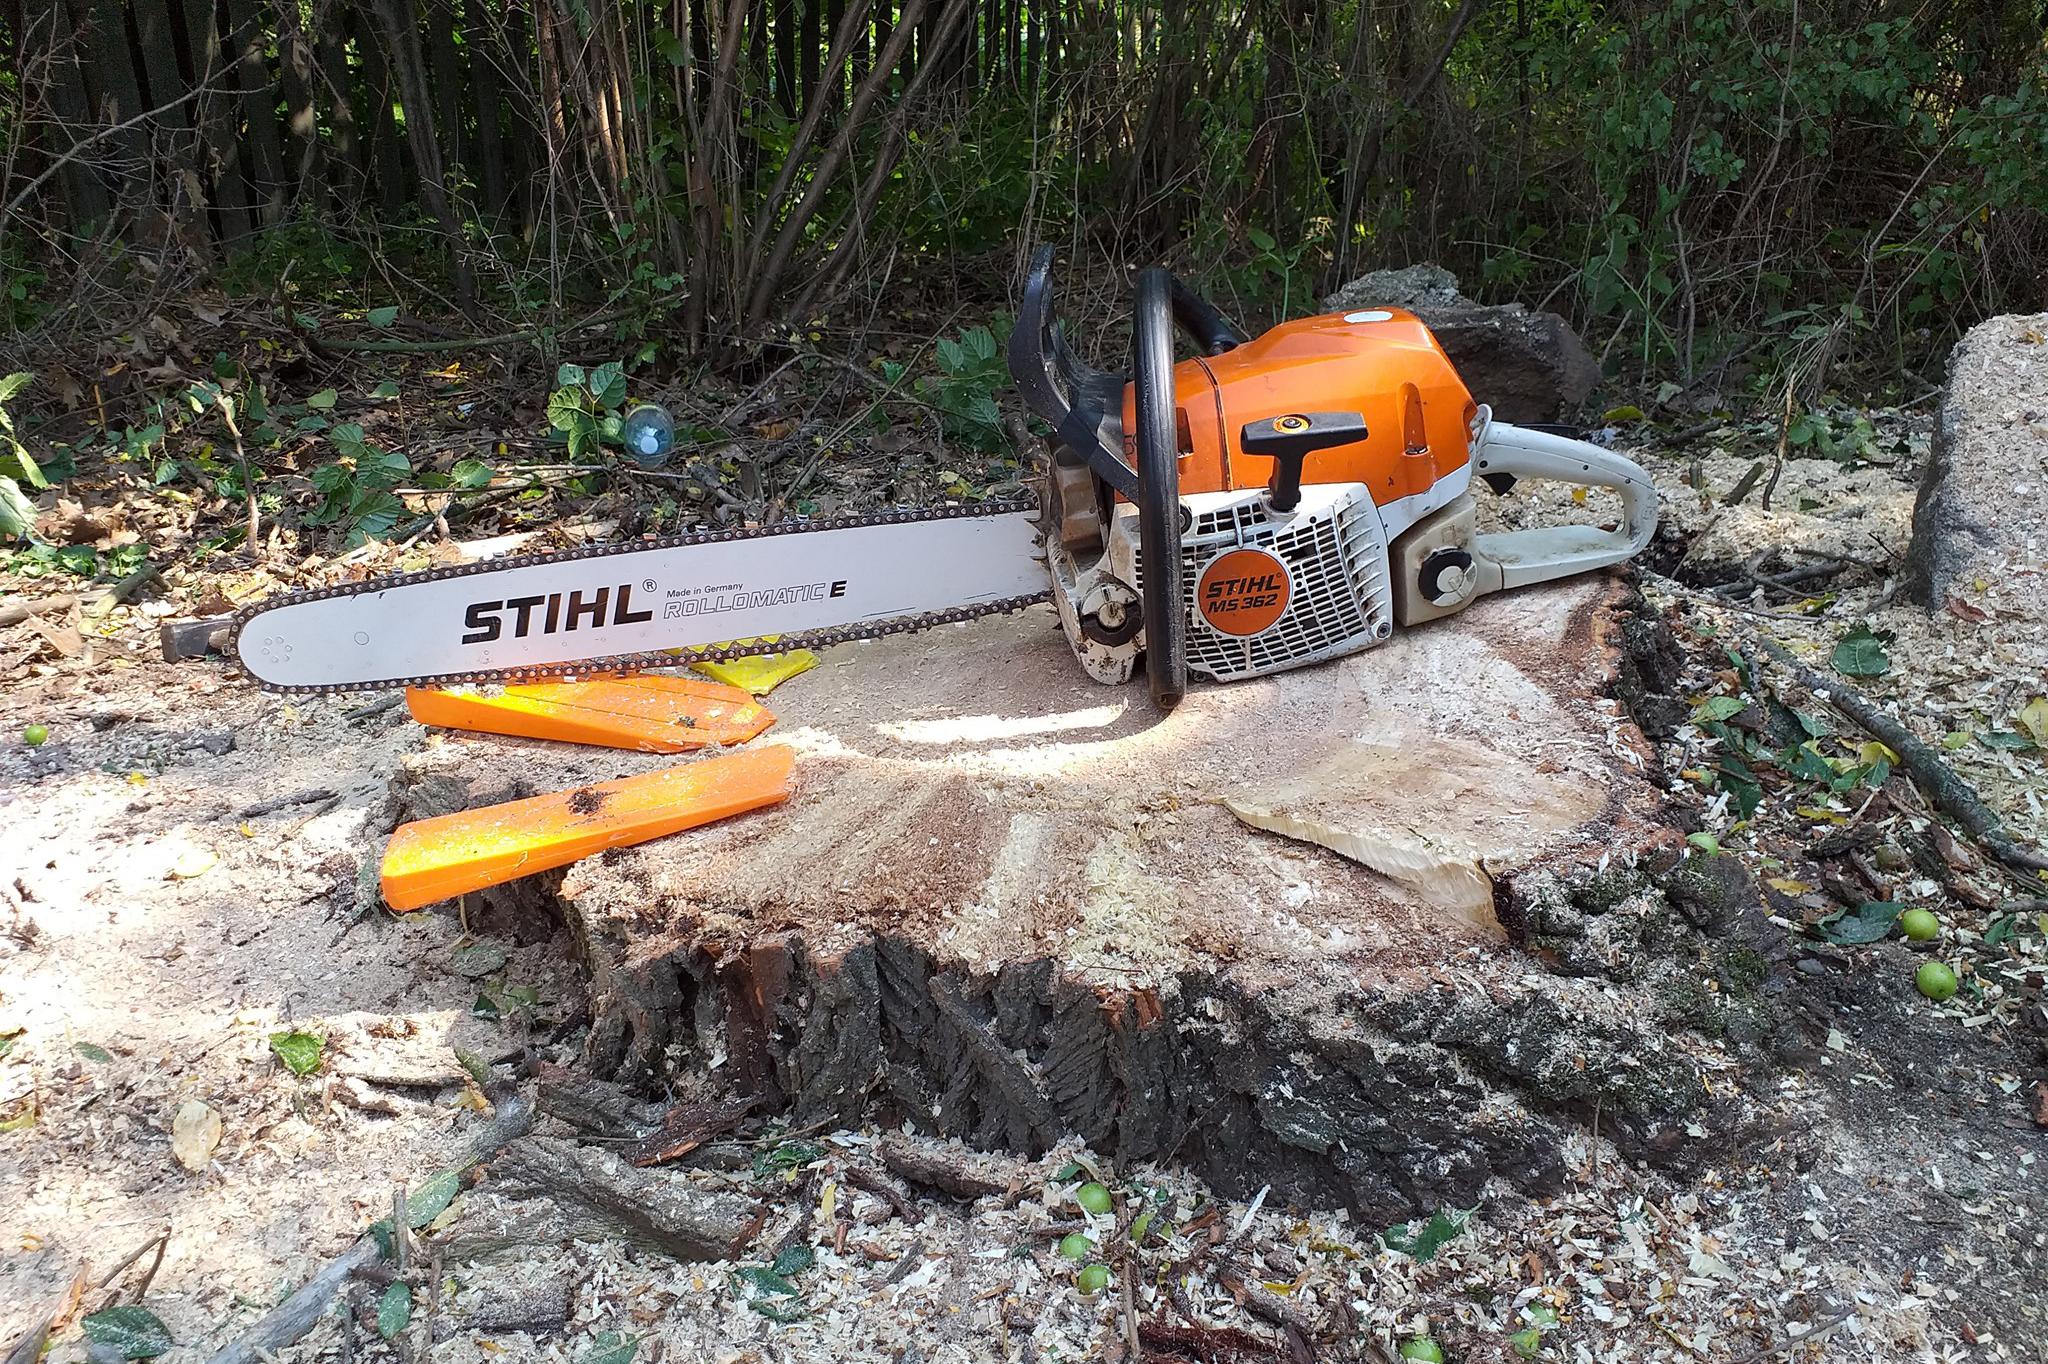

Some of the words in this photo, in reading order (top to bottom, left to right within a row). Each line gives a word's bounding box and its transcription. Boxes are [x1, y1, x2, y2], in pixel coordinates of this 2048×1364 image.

[663, 582, 826, 619] ROLLOMATIC
[667, 589, 691, 599] Made
[694, 588, 702, 597] in
[704, 583, 743, 595] Germany
[1207, 598, 1239, 613] MS
[1240, 594, 1278, 609] 362
